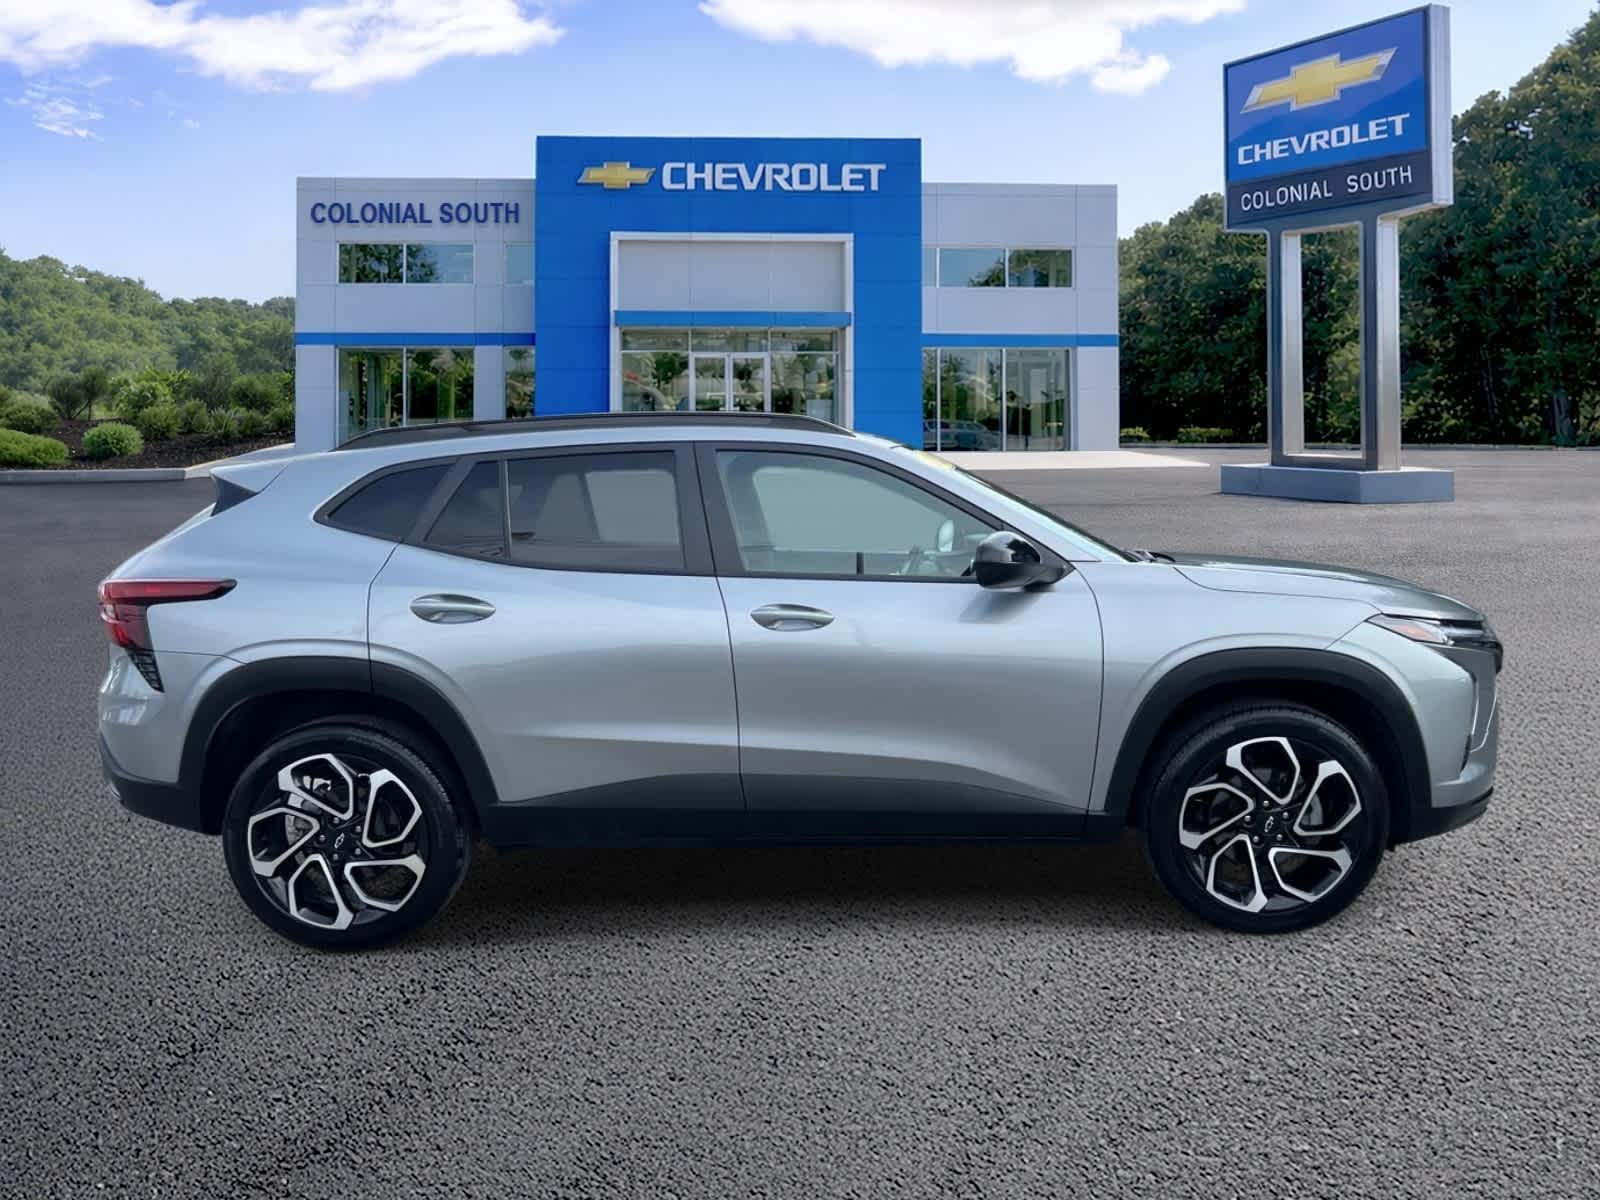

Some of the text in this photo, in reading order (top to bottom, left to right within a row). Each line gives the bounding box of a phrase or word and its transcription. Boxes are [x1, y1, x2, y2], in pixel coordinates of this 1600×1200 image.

[1237, 113, 1410, 165] CHEVROLET
[661, 161, 887, 193] CHEVROLET
[1241, 165, 1412, 211] COLONIAL SOUTH
[310, 202, 520, 225] COLONIAL SOUTH
